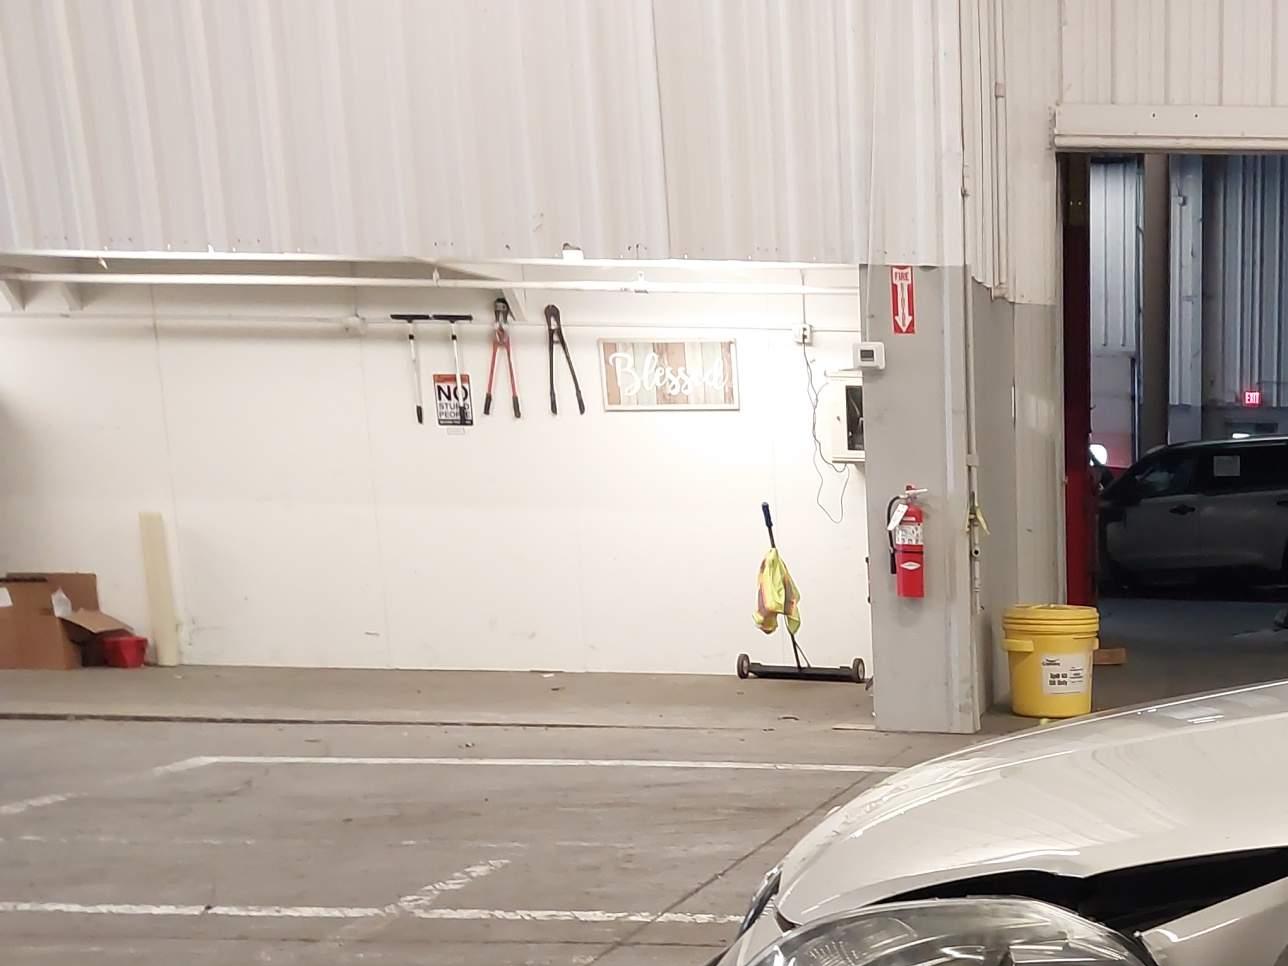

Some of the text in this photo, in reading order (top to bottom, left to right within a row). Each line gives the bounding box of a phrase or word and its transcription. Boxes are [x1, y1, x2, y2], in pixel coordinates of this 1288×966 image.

[895, 271, 910, 281] FIRE
[437, 384, 468, 402] NO
[1245, 391, 1260, 404] EXIT
